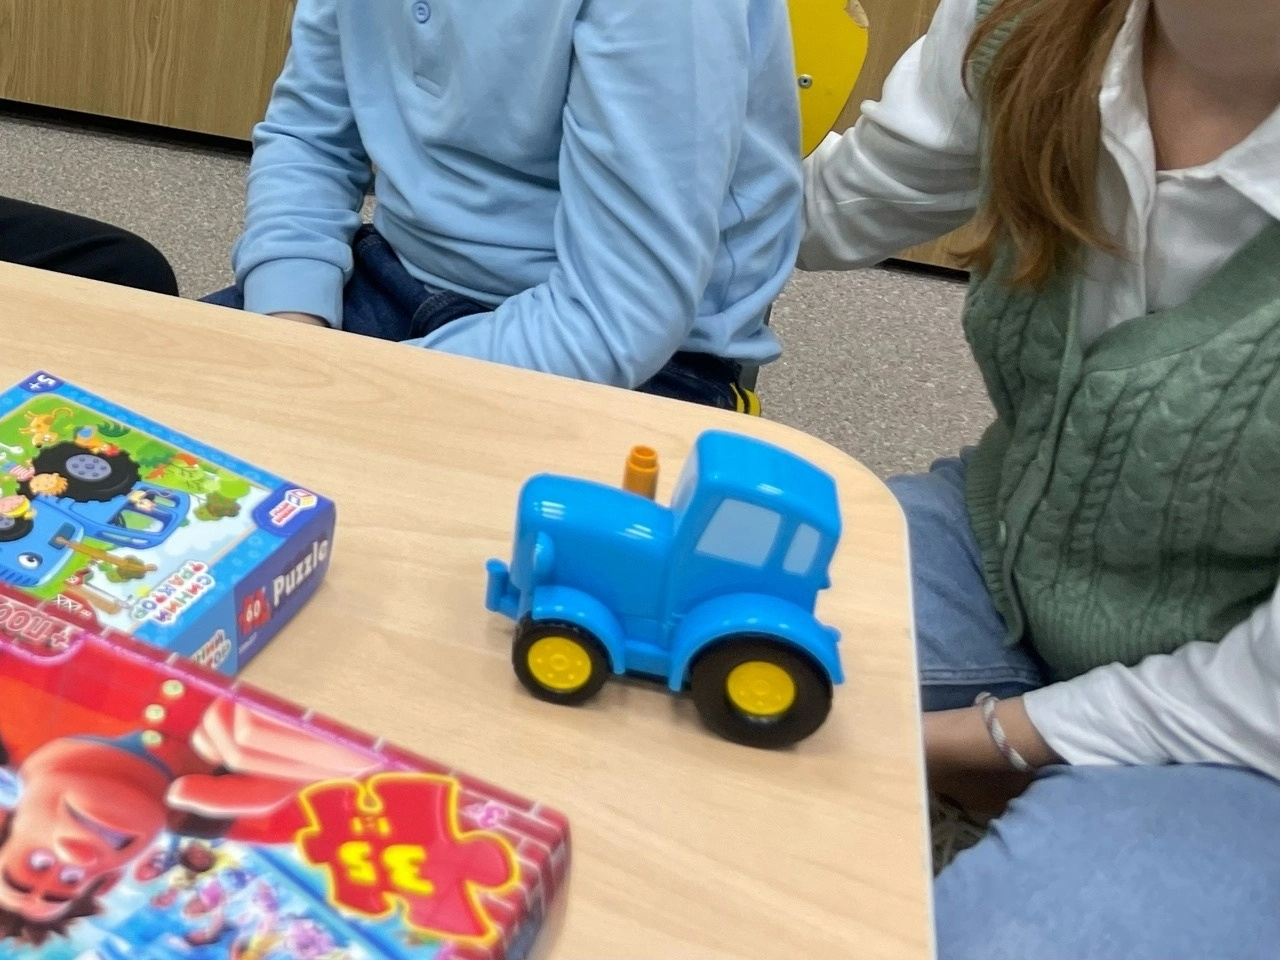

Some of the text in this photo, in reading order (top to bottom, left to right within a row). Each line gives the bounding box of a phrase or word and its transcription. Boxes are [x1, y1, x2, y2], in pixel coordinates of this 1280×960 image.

[29, 374, 56, 388] 5+
[133, 561, 204, 619] ТРАКТОР
[153, 575, 211, 622] СИНИЙ
[273, 540, 329, 607] Puzzle
[246, 599, 261, 623] 60
[337, 841, 435, 896] 35
